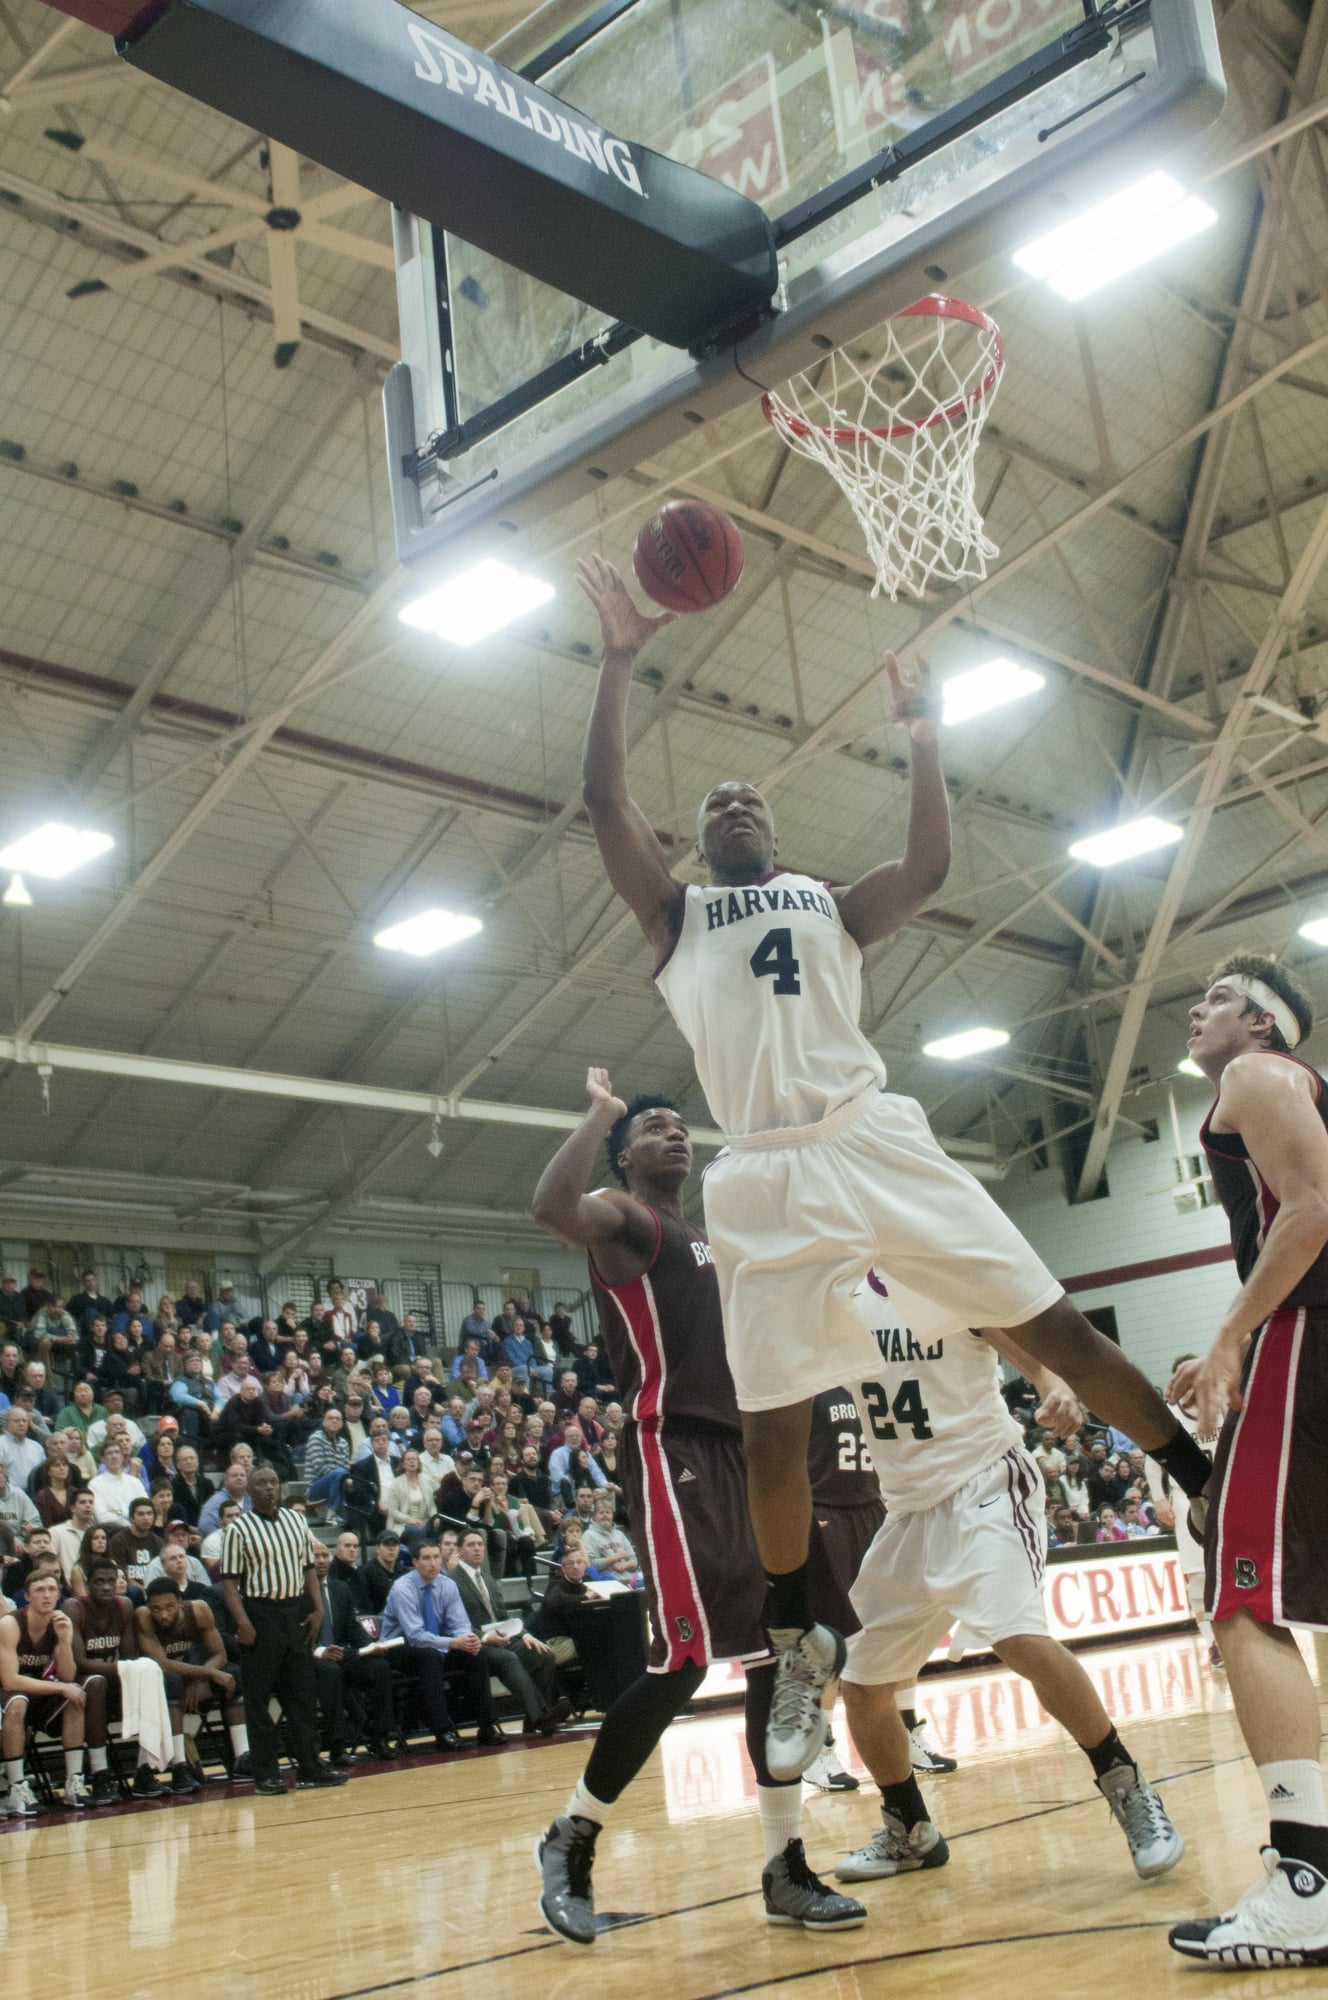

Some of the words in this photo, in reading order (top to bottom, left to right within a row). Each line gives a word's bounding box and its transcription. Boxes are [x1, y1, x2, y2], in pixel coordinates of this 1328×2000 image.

[406, 23, 645, 199] SPALDING
[705, 889, 834, 931] HARVARD
[750, 927, 801, 996] 4
[871, 1328, 944, 1363] VARD
[829, 1403, 861, 1422] BRO
[861, 1379, 935, 1441] 24
[1051, 1559, 1185, 1630] CRIM
